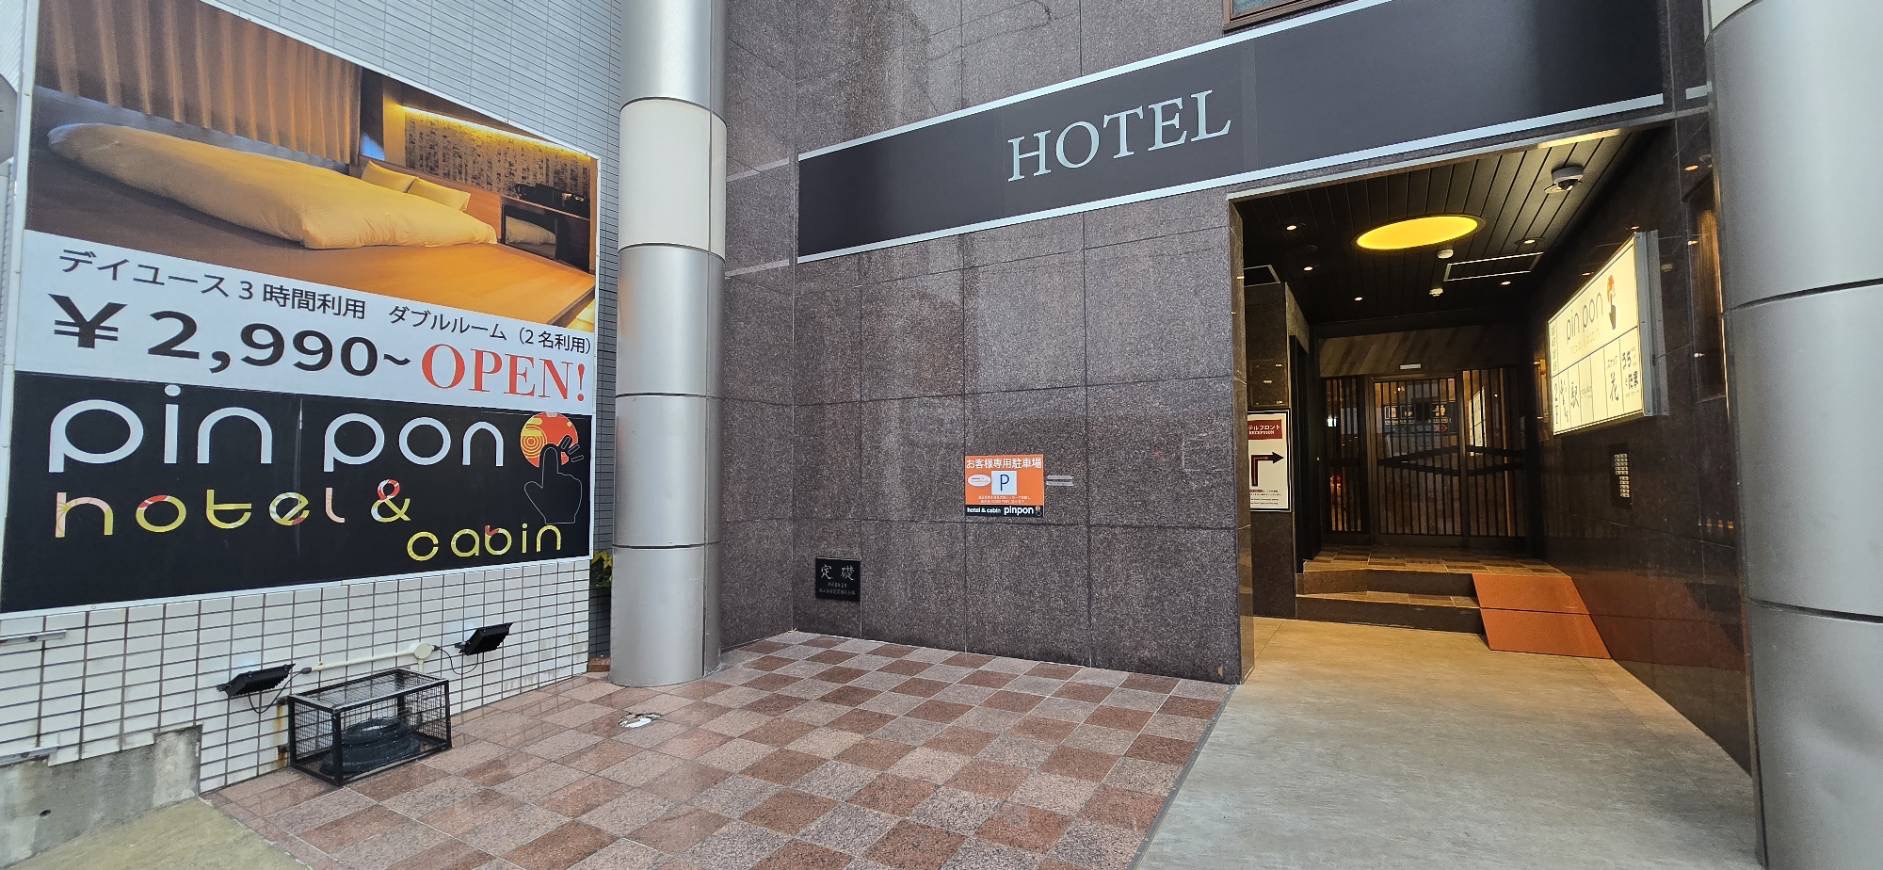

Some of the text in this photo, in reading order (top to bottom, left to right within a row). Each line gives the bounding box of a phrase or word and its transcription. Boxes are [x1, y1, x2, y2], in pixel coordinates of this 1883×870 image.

[1008, 89, 1231, 182] HOTEL
[421, 343, 586, 402] OPEN!
[49, 384, 504, 473] pin pon
[966, 457, 1041, 469] お客様専用駐車場
[1000, 474, 1009, 491] P
[55, 478, 411, 538] hotel &
[1003, 505, 1034, 516] pinpon
[407, 523, 562, 562] cabin
